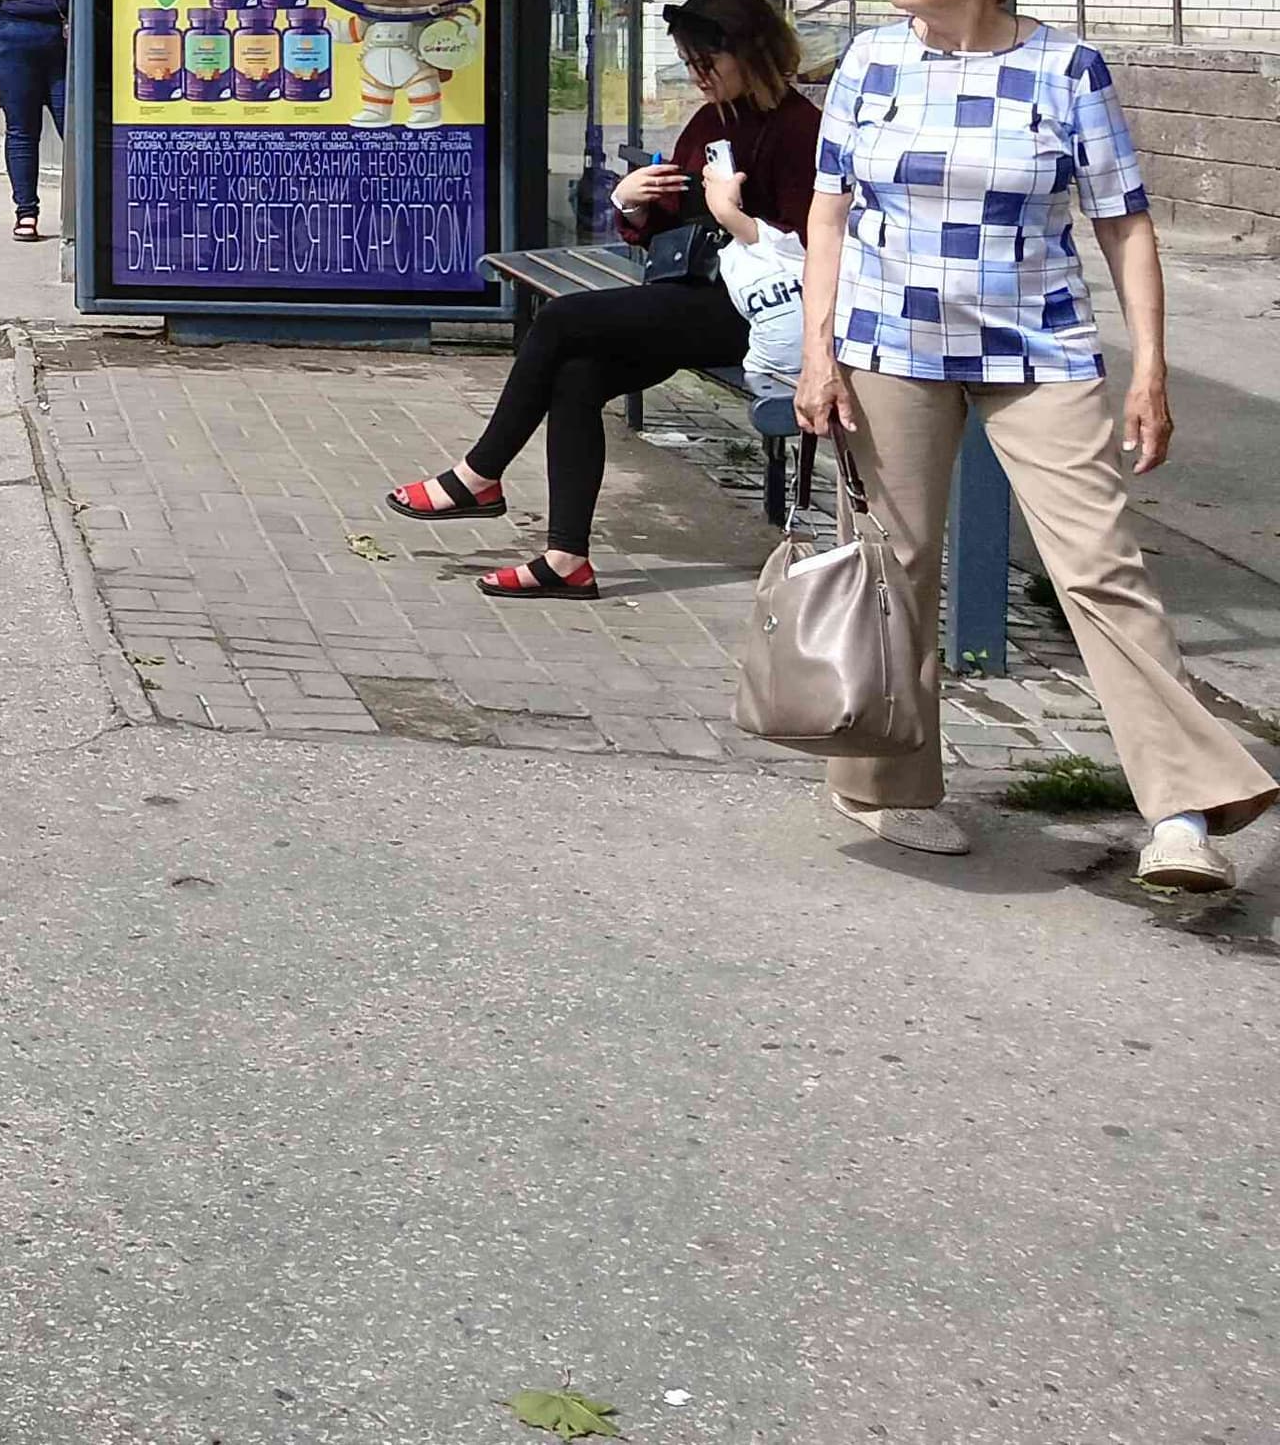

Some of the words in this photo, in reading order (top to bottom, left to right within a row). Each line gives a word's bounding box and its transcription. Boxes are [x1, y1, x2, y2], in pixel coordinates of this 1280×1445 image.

[220, 131, 231, 141] ПО
[127, 151, 199, 176] ИМЕЮТСЯ
[203, 151, 365, 177] ПРОТИВОПОКАЗАНИЯ.
[368, 151, 472, 177] НЕОБХОДИМО
[127, 176, 219, 201] ПОЛУЧЕНИЕ
[227, 176, 350, 204] КОНСУЛЬТАЦИИ
[360, 176, 473, 203] СПЕЦИАЛИСТА
[127, 202, 176, 273] БАД.
[181, 202, 209, 272] НЕ
[212, 202, 321, 272] ЯВЛЯЕТСЯ
[324, 203, 473, 274] ЛЕКАРСТВОМ
